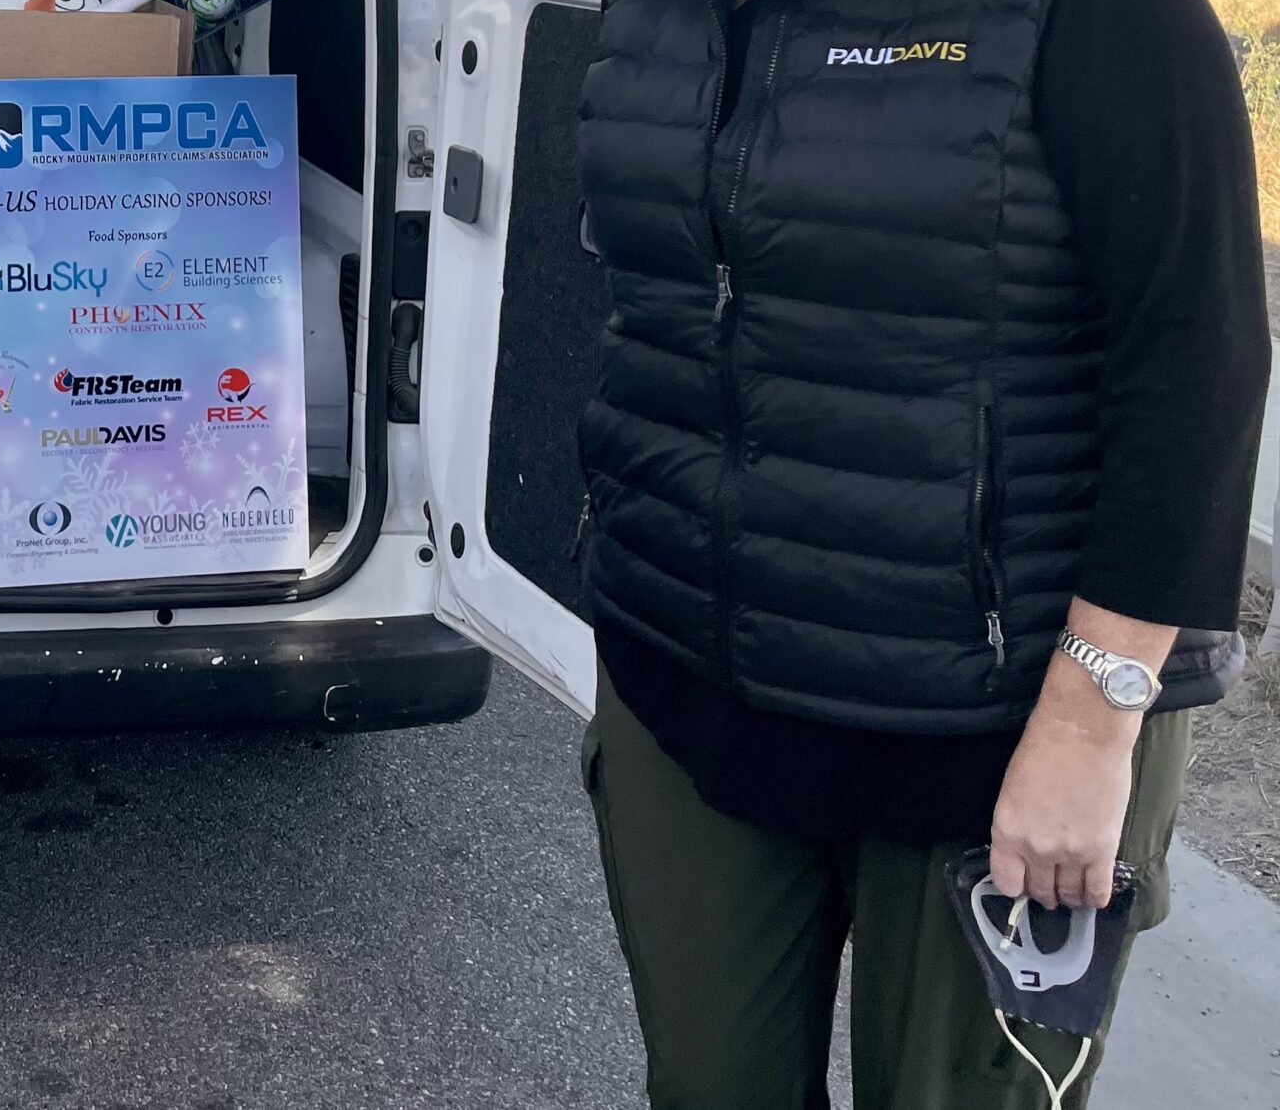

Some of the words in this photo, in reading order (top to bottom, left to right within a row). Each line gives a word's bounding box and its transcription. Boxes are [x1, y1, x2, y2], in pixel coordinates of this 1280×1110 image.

[32, 101, 268, 153] RMPCA
[32, 154, 64, 164] ROCKY
[67, 153, 117, 163] MOUNTAIN
[119, 152, 169, 162] PROPERTY
[171, 151, 206, 161] CLAIMS
[208, 150, 269, 160] ASSOCIATION
[45, 194, 117, 211] HOLIDAY
[121, 193, 181, 209] CASINO
[186, 190, 272, 207] SPONSORS!
[88, 230, 115, 242] Food
[117, 229, 168, 244] Sponsors
[144, 262, 164, 278] E2
[183, 256, 269, 275] ELEMENT
[7, 261, 108, 298] BluSky
[183, 275, 231, 288] Building
[234, 274, 283, 286] Sciences
[69, 325, 128, 335] CONTENTS
[130, 322, 207, 332] RESTORATION
[72, 374, 182, 397] FRSTeam
[71, 396, 93, 406] Fabric
[94, 396, 136, 405] Restoration
[137, 395, 162, 404] Service
[164, 394, 183, 403] Team
[207, 405, 268, 423] REX
[139, 512, 206, 534] YOUNG
[222, 508, 295, 528] NEDERVELD
[16, 538, 43, 547] ProNet
[45, 536, 72, 547] Group,
[74, 535, 88, 544] Inc.
[151, 533, 206, 543] ASSOCIATES
